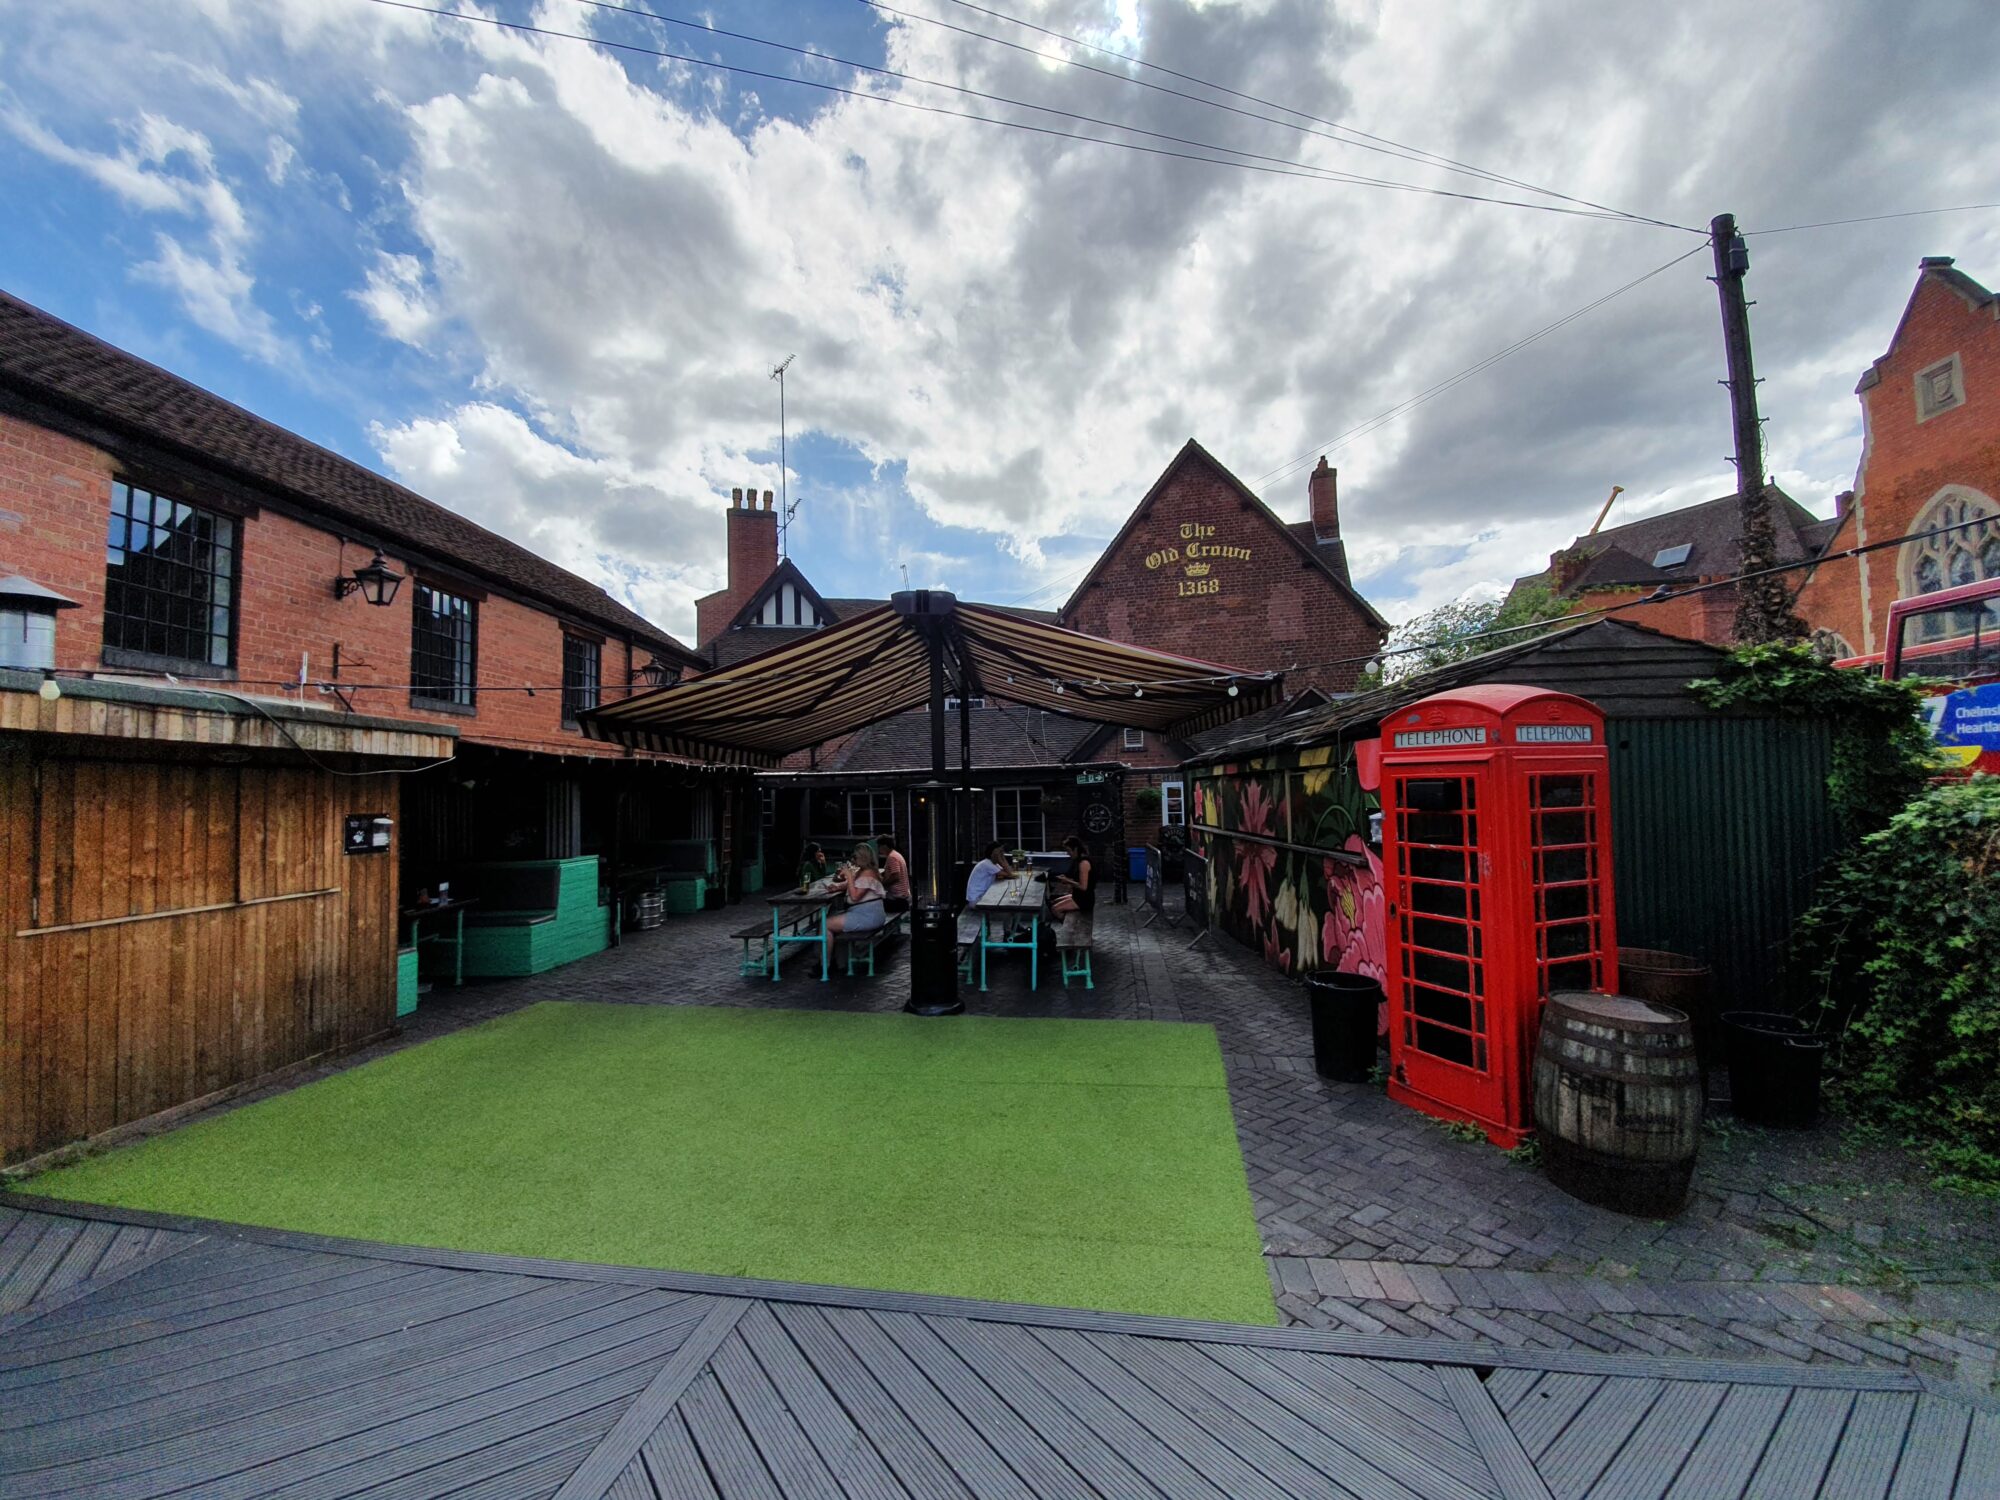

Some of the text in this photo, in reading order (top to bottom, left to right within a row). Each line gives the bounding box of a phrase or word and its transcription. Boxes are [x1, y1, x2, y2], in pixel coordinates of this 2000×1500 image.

[1179, 523, 1216, 540] The
[1145, 542, 1252, 569] Old Crown
[1177, 579, 1220, 597] 1368
[1518, 726, 1589, 741] TELEPHONE
[1956, 720, 2000, 734] Heartla
[1399, 728, 1484, 746] TELEPHONE
